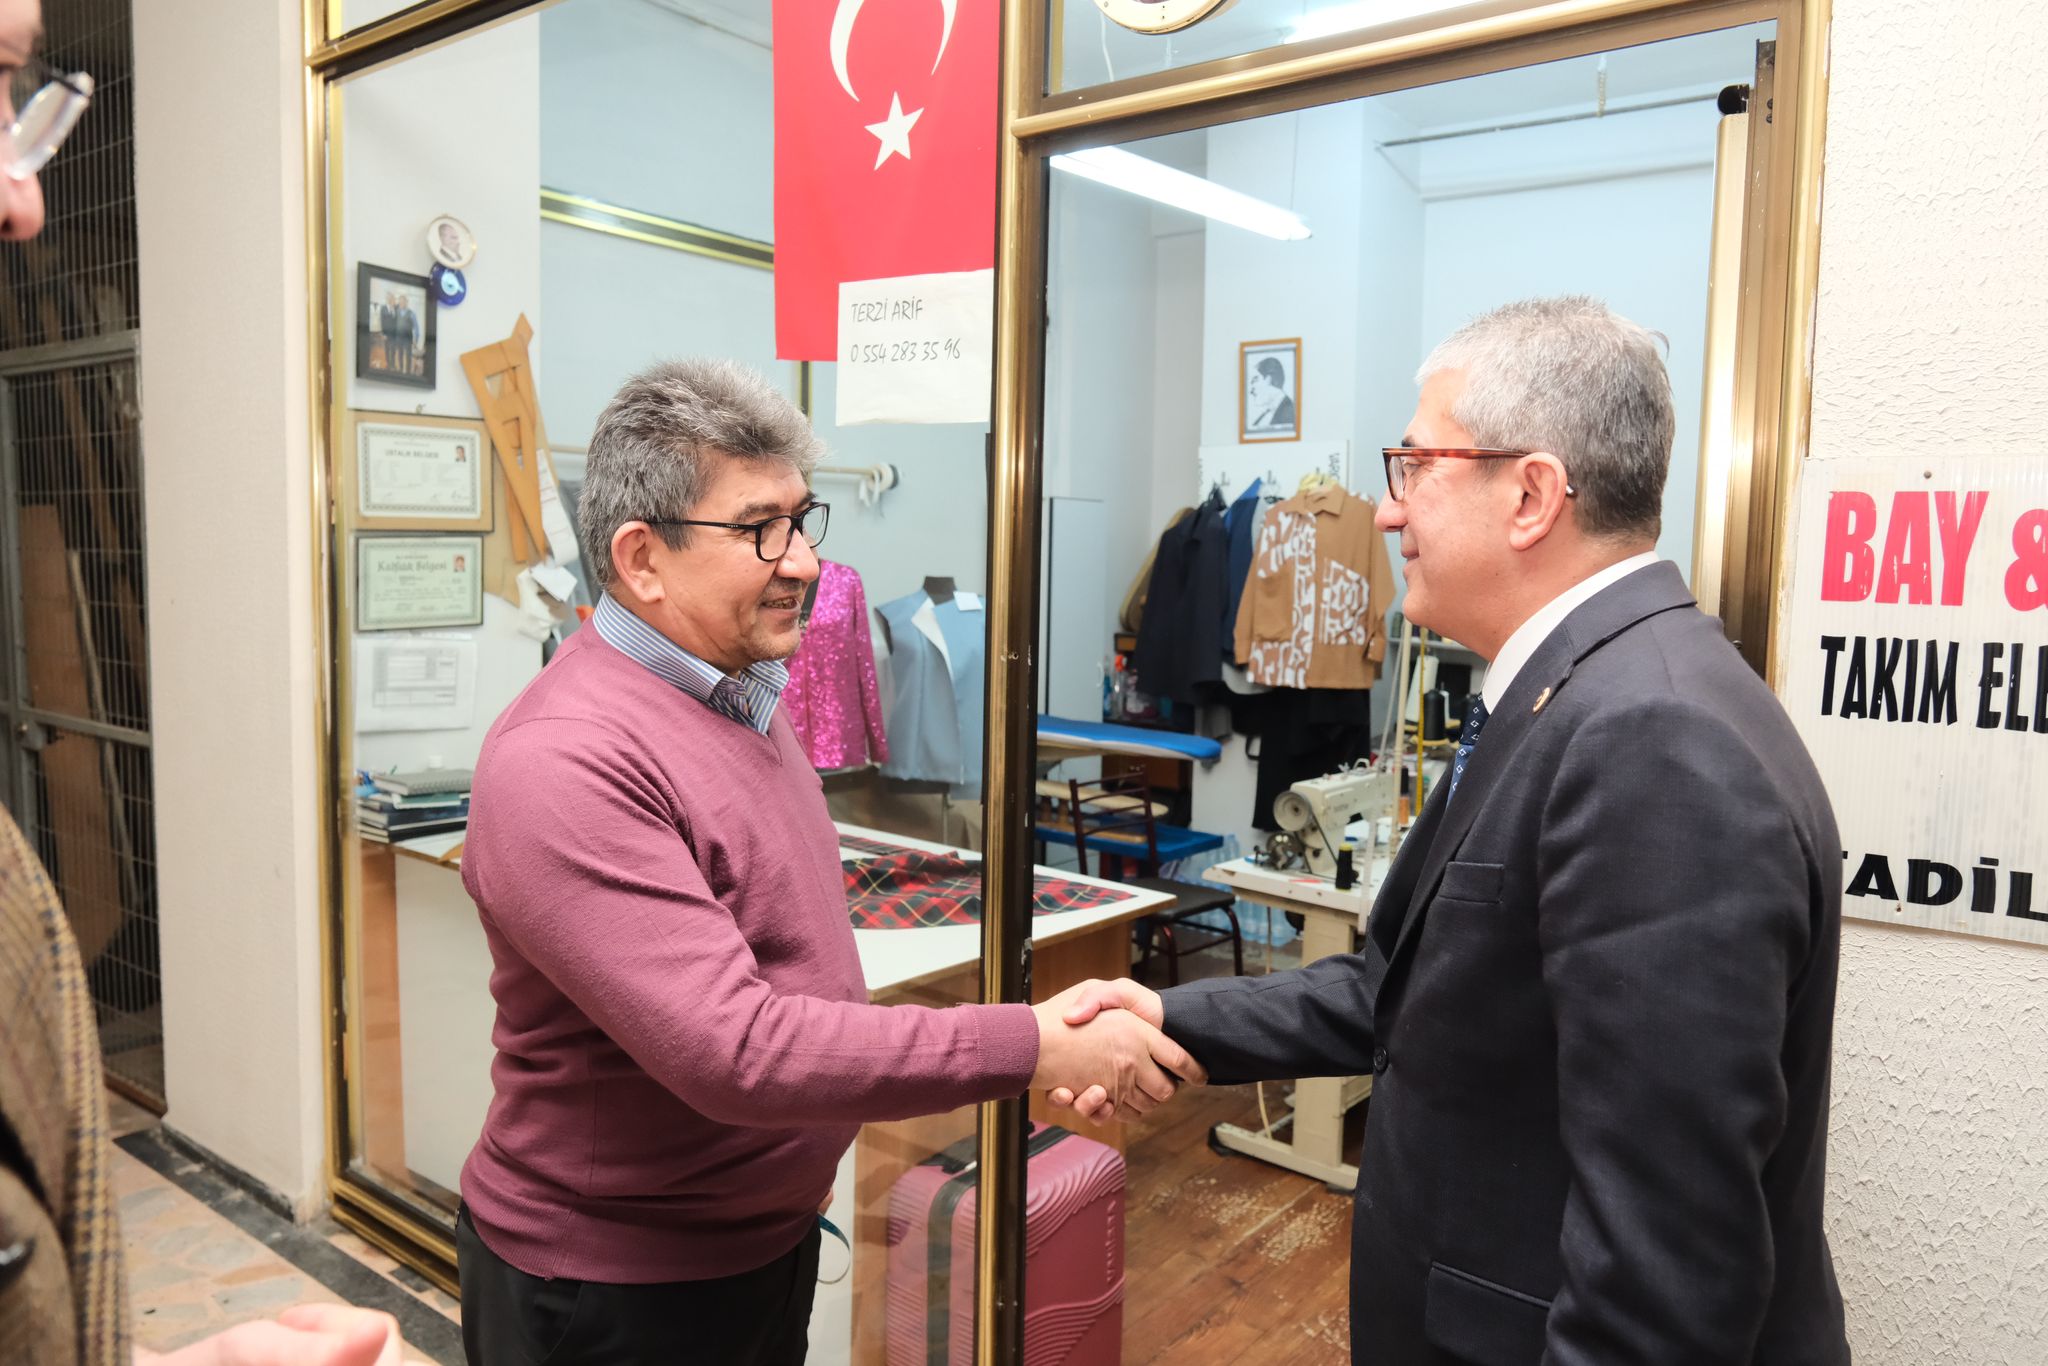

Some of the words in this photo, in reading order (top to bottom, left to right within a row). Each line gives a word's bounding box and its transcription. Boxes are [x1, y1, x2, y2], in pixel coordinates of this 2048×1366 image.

[851, 297, 889, 323] TERZİ
[891, 295, 923, 321] ARİF
[850, 343, 859, 362] 0
[863, 342, 887, 363] 554
[890, 340, 917, 362] 283
[921, 341, 939, 361] 35
[944, 338, 961, 360] 96
[1821, 491, 1990, 606] BAY
[1821, 635, 1960, 726] TAKIM
[1842, 850, 2048, 922] ADİL
